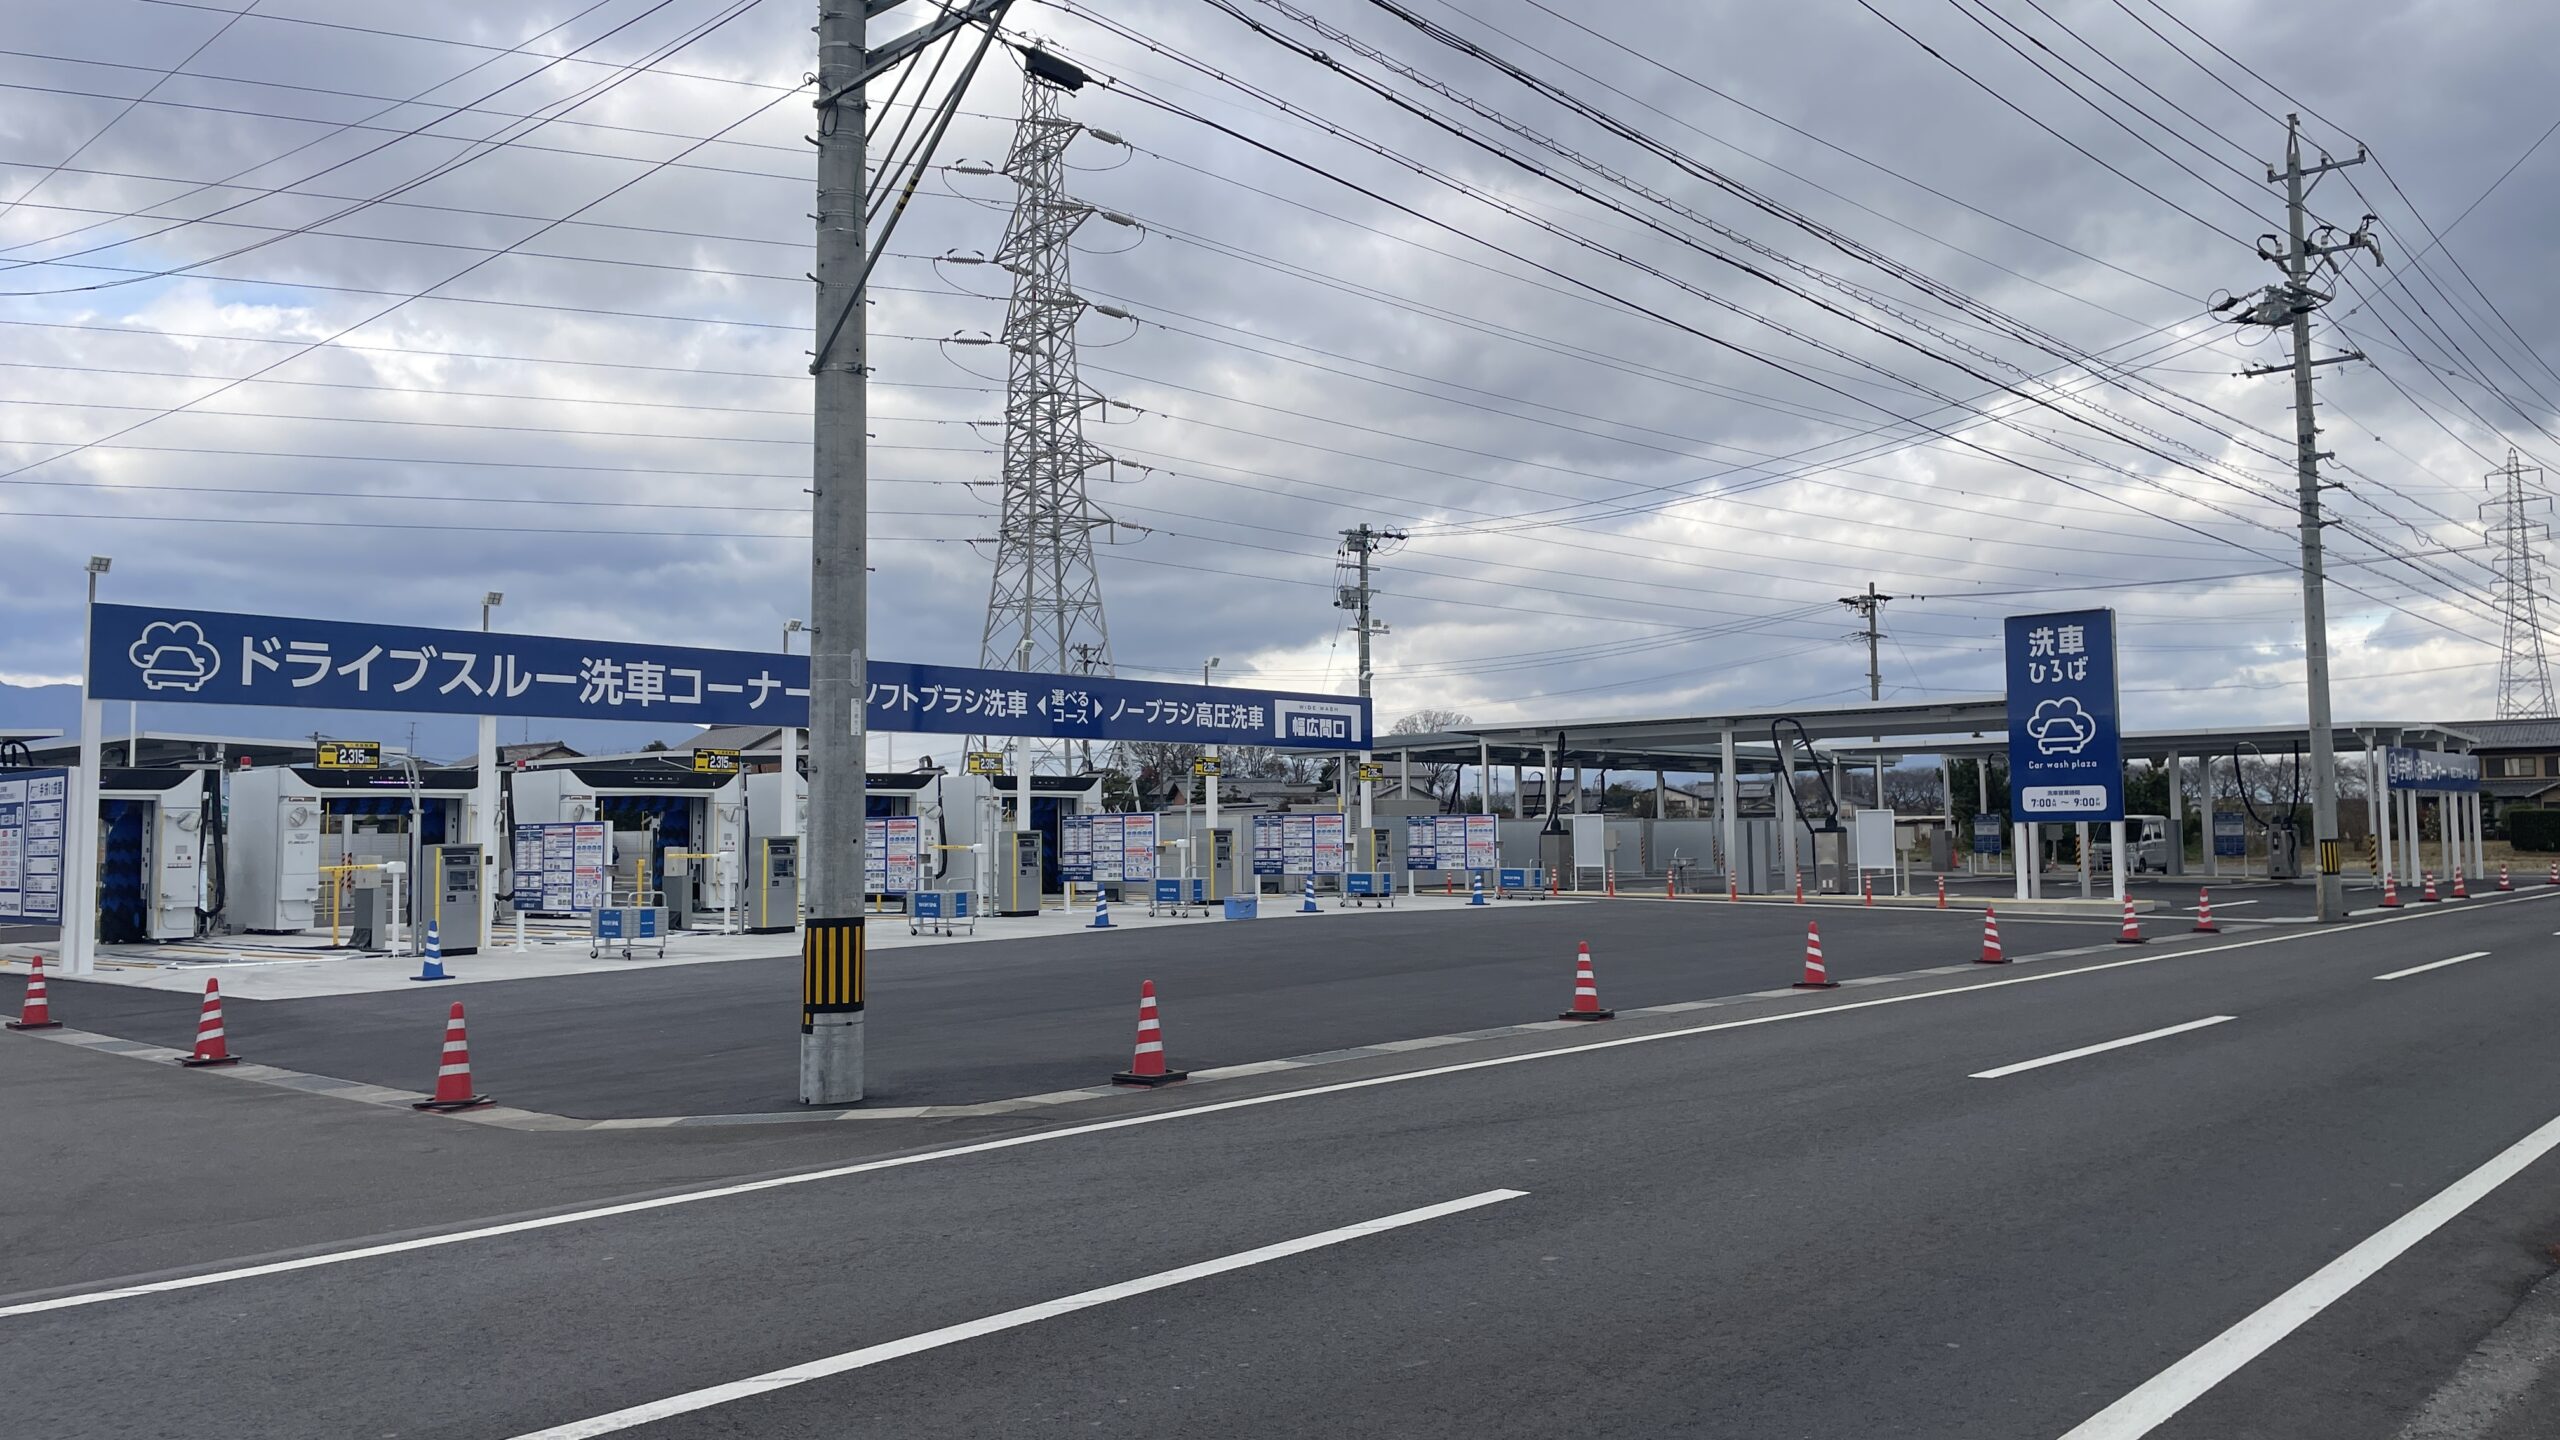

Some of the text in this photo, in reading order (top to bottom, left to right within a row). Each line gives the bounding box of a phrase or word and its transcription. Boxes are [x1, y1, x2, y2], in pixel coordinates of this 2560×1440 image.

[2028, 624, 2085, 658] 洗車
[241, 635, 810, 710] ドライブスルー洗車コーナー
[2028, 656, 2089, 684] ひろば
[1051, 688, 1089, 707] 選べる
[1053, 708, 1089, 724] コース
[1109, 698, 1265, 731] ノーブラシ高圧洗車
[1292, 716, 1345, 739] 幅広間口
[2028, 759, 2097, 770] Car wash plaza
